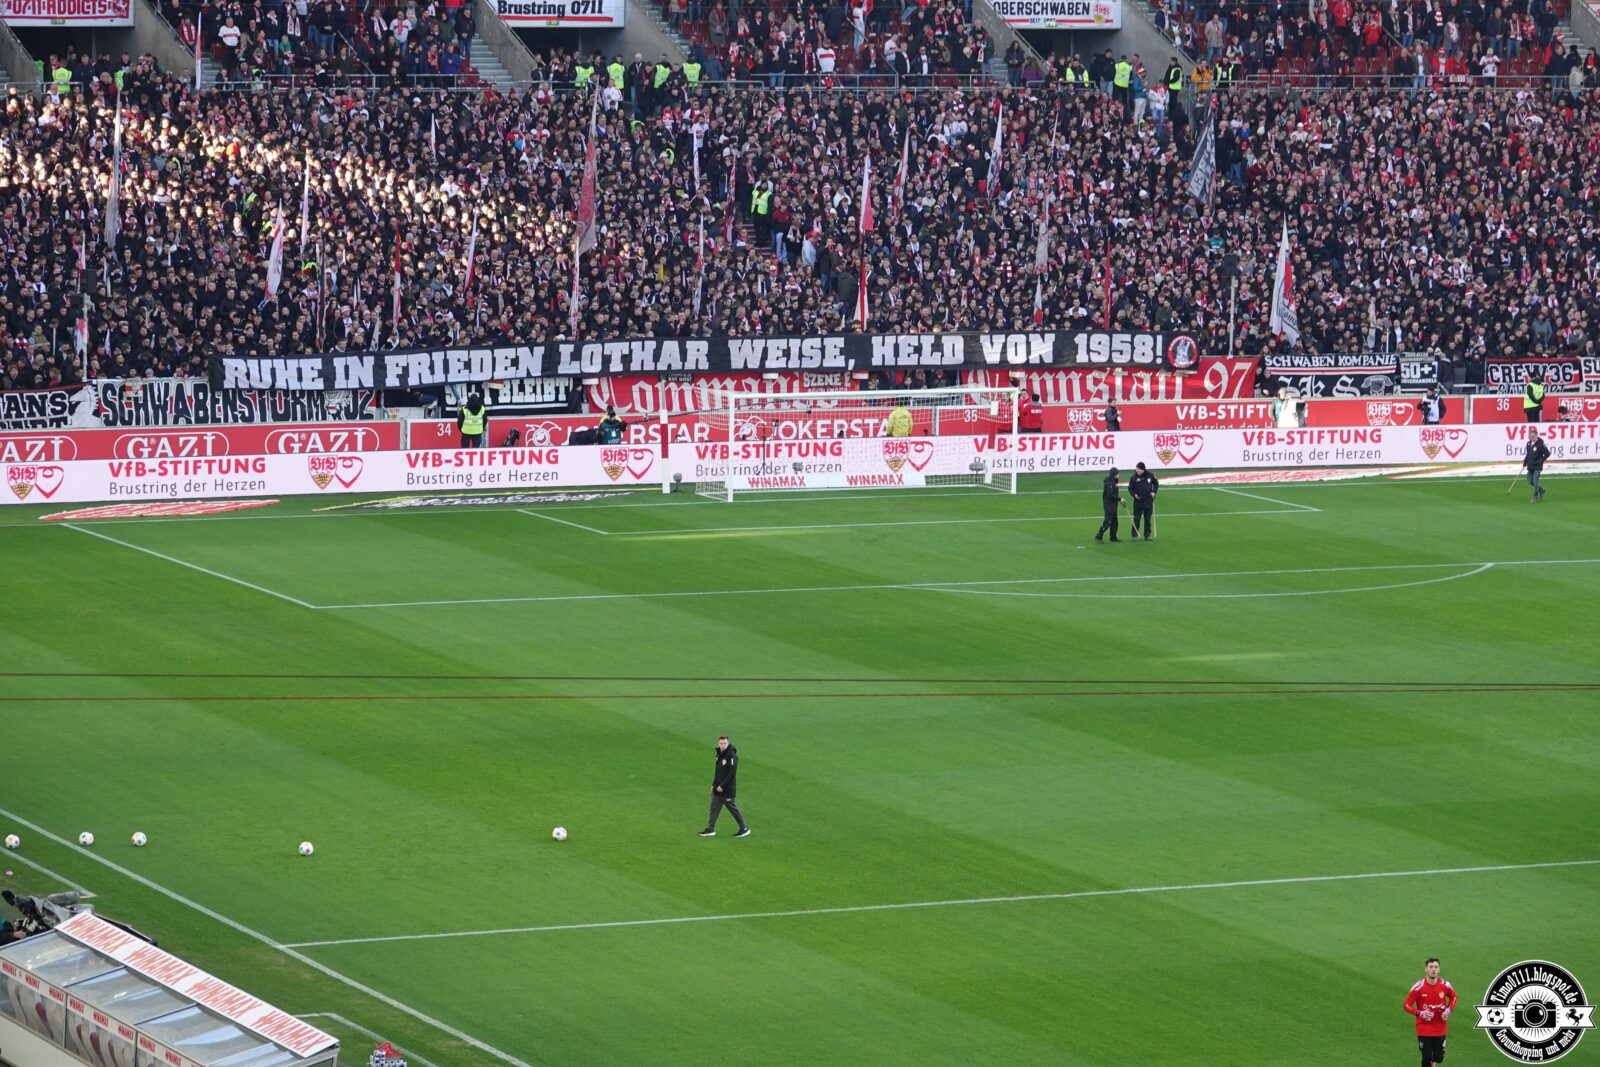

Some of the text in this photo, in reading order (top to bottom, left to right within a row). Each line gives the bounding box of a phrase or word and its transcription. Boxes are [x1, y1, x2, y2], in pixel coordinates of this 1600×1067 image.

[498, 0, 603, 18] Brustring 0711
[994, 2, 1091, 16] OBERSCHWABEN
[223, 357, 324, 390] RUHE
[333, 355, 375, 389] IN
[384, 346, 546, 388] FRIEDEN
[557, 340, 709, 374] LOTHAR
[728, 337, 856, 371] WEISE,
[871, 335, 965, 366] HELD
[980, 333, 1056, 364] VON
[1074, 333, 1164, 364] 1958!
[1264, 355, 1333, 368] SCHWABEN
[1338, 353, 1398, 368] KOMPANIE
[1401, 361, 1438, 379] 50+1
[966, 368, 1187, 406] Cnnstatt
[1203, 361, 1253, 400] 97
[0, 391, 69, 421] ANS
[1176, 403, 1274, 420] VfB-STIFT
[1496, 398, 1510, 411] 36
[964, 409, 978, 423] 35
[437, 422, 452, 436] 34
[1243, 429, 1383, 447] VfB-STIFTUNG
[1506, 424, 1600, 440] VfB-STIFT
[695, 440, 843, 460] VfB-STIFTUNG
[974, 434, 1115, 452] VB-STIFTUNG
[1570, 443, 1589, 455] der
[406, 449, 559, 468] VfB-STIFTUNG
[1040, 454, 1061, 468] der
[1067, 453, 1114, 467] Herzen
[1243, 447, 1382, 464] Brustring der Herzen
[109, 457, 267, 478] VfB-STIFTUNG
[765, 461, 788, 475] der
[797, 459, 842, 474] erzen
[406, 467, 558, 487] Brustring der Herzen
[748, 476, 806, 489] WINAMAX
[847, 474, 905, 487] WINAMAX
[109, 476, 266, 497] Brustring der Herzen
[122, 945, 198, 986] WINAMAX
[185, 977, 262, 1019] WINAMAX
[250, 1010, 330, 1054] WINAMAX
